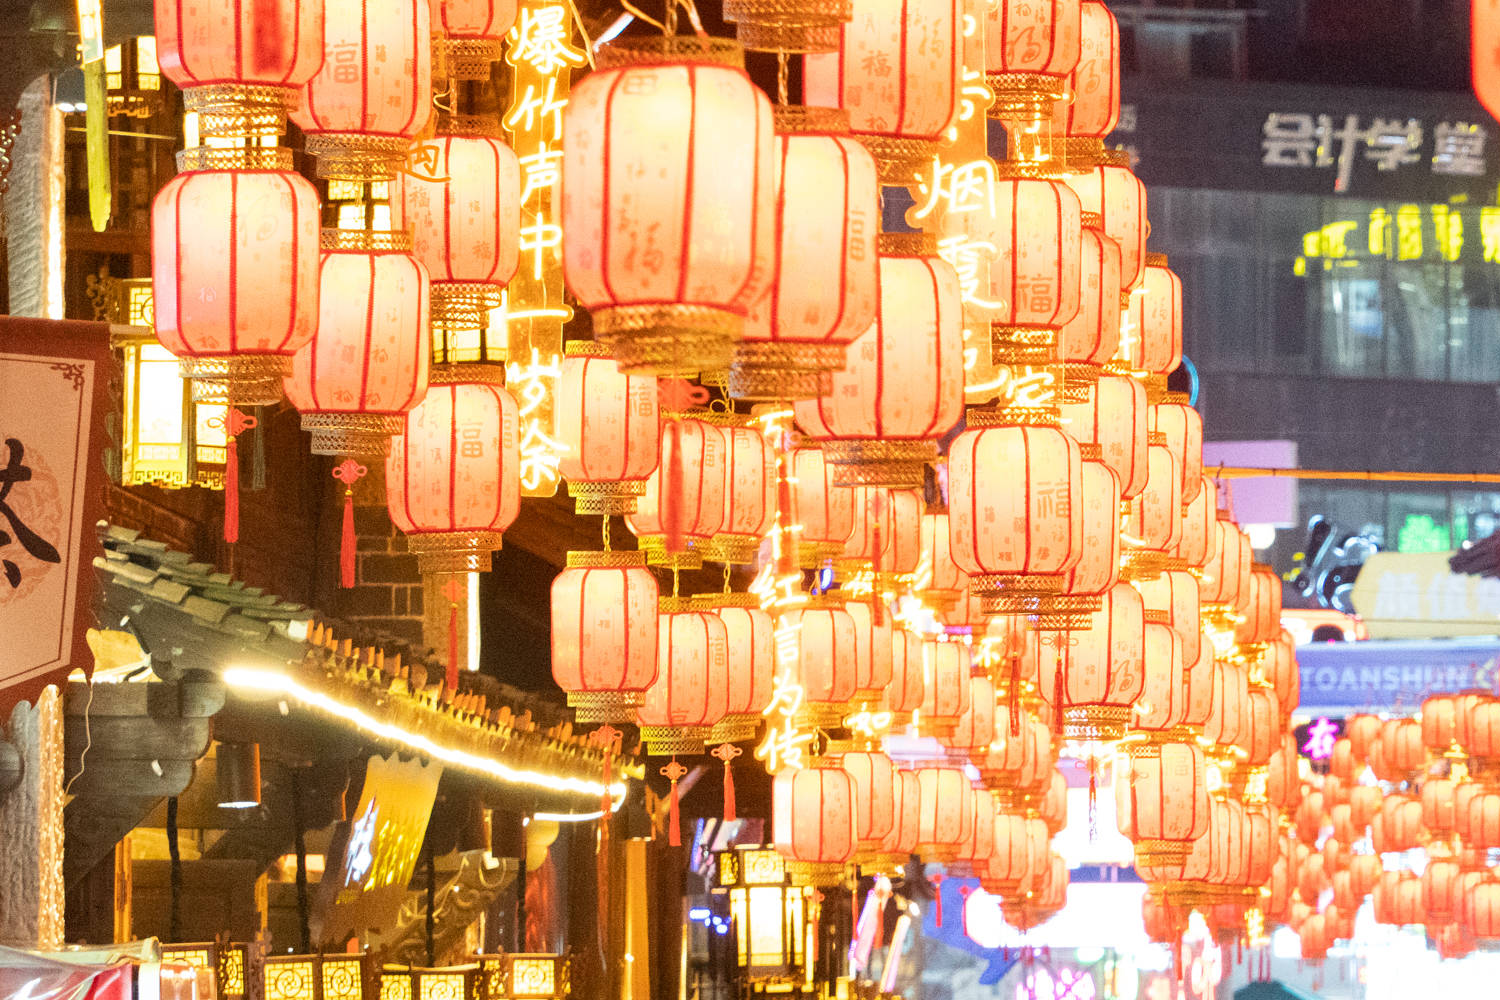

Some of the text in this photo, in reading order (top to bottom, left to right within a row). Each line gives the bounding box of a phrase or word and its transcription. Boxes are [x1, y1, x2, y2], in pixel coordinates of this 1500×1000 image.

[1262, 112, 1487, 192] 会计学堂
[1016, 275, 1054, 314] 福
[1036, 480, 1070, 519] 福
